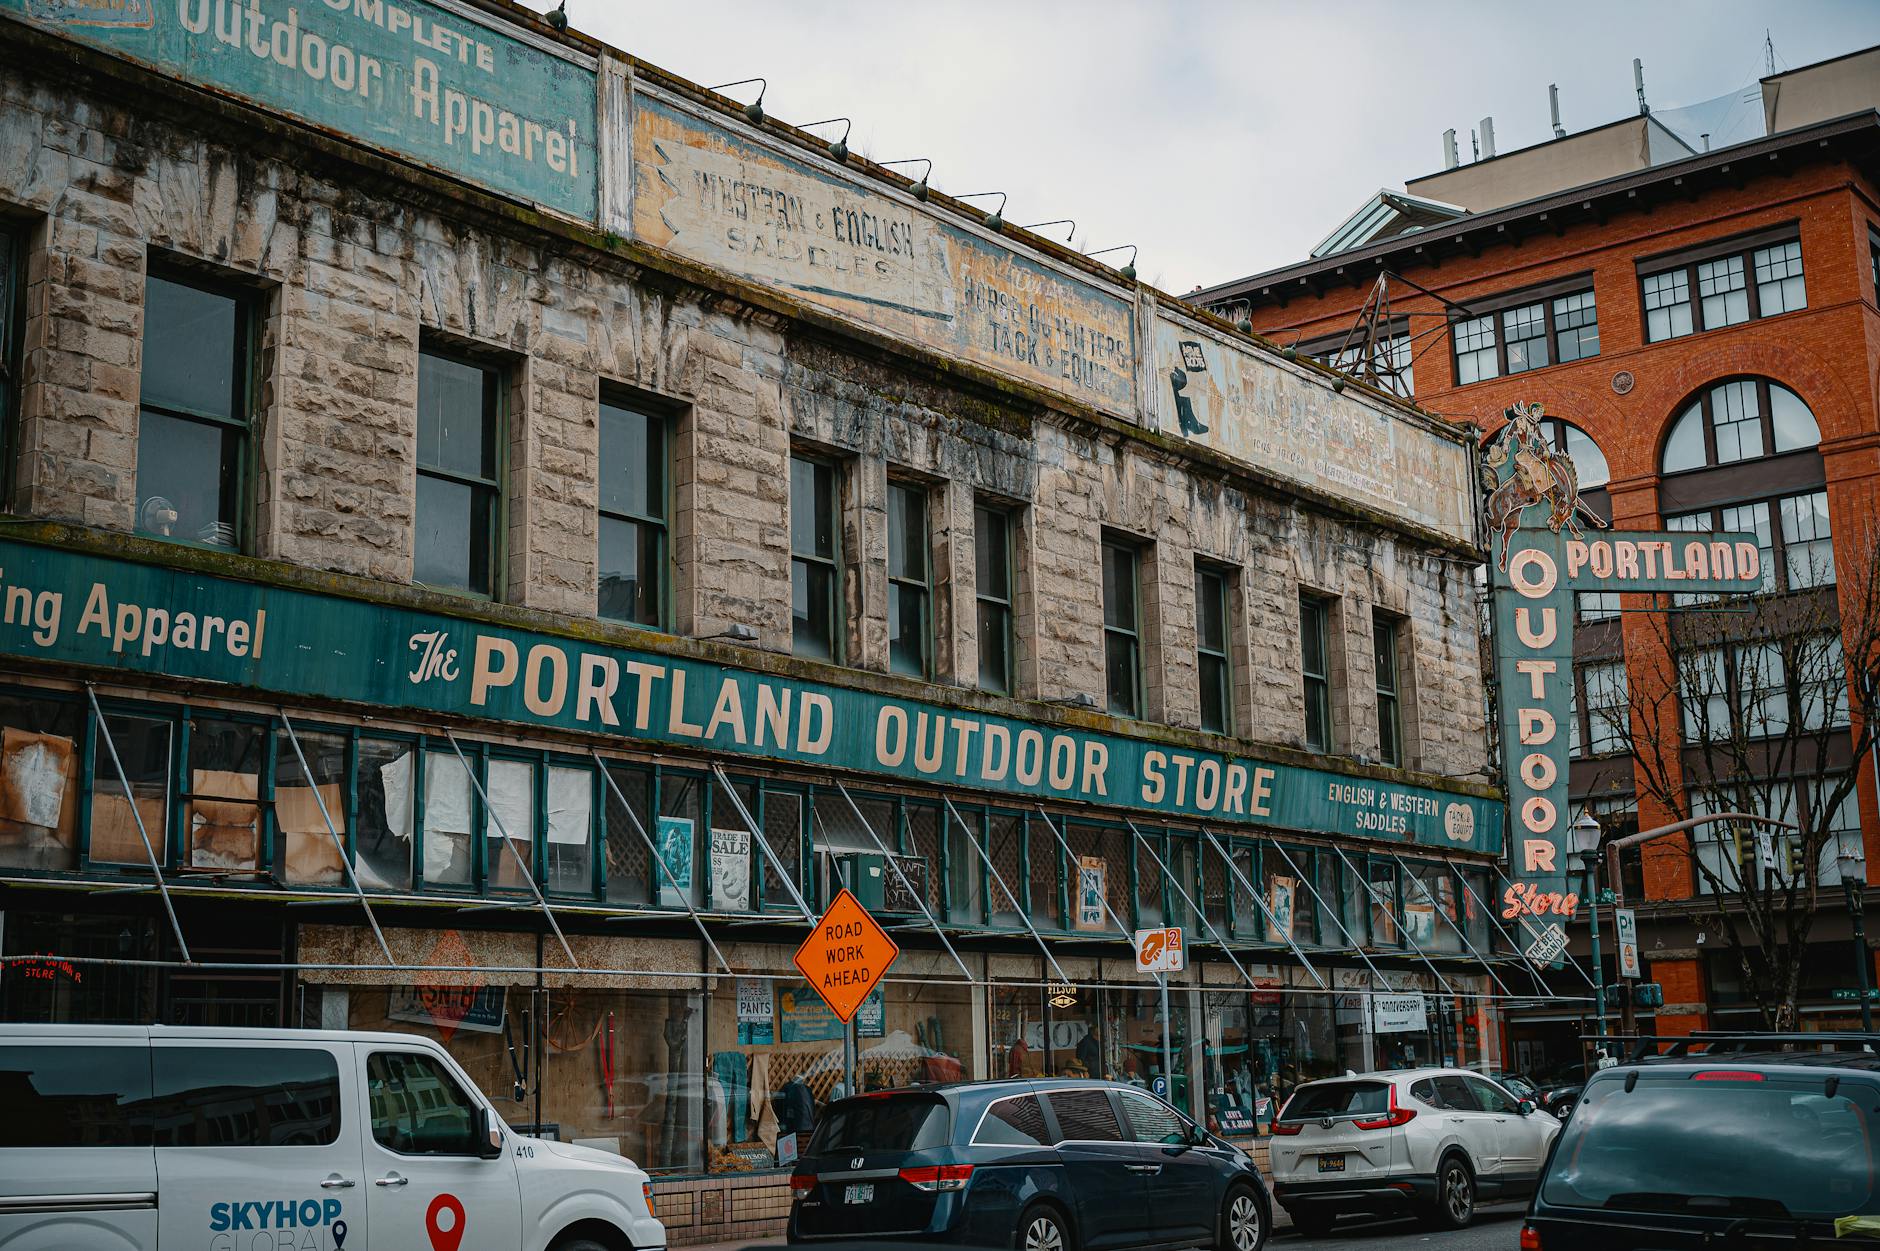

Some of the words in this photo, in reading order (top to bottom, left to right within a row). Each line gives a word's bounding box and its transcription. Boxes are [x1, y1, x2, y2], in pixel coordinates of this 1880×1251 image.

[322, 0, 494, 73] MPLETE
[178, 0, 382, 97] Outdoor
[410, 56, 579, 178] Apparel
[832, 205, 914, 260] ENGLISH
[989, 321, 1039, 367] TACK
[1566, 541, 1760, 580] PORTLAND
[0, 566, 63, 648] ng
[77, 583, 266, 661] Apparel
[1509, 549, 1558, 872] OUTDOOR
[408, 630, 459, 684] The
[470, 635, 834, 755] PORTLAND
[876, 705, 1109, 796] OUTDOOR
[1142, 750, 1276, 817] STORE
[1328, 783, 1375, 807] ENGLISH
[1380, 792, 1387, 809] &
[1390, 793, 1439, 817] WESTERN
[1356, 811, 1406, 834] SADDLES
[712, 840, 749, 855] SALE
[713, 832, 738, 842] TRADE
[1502, 883, 1579, 919] Store
[826, 922, 862, 941] ROAD
[1169, 931, 1178, 946] 2
[826, 945, 864, 964] WORK
[1528, 944, 1544, 957] THE
[25, 968, 55, 980] STORE
[824, 968, 869, 988] AHEAD
[740, 1002, 771, 1014] PANTS
[1157, 1081, 1165, 1093] P
[516, 1145, 534, 1158] 410
[209, 1199, 342, 1231] SKYHOP
